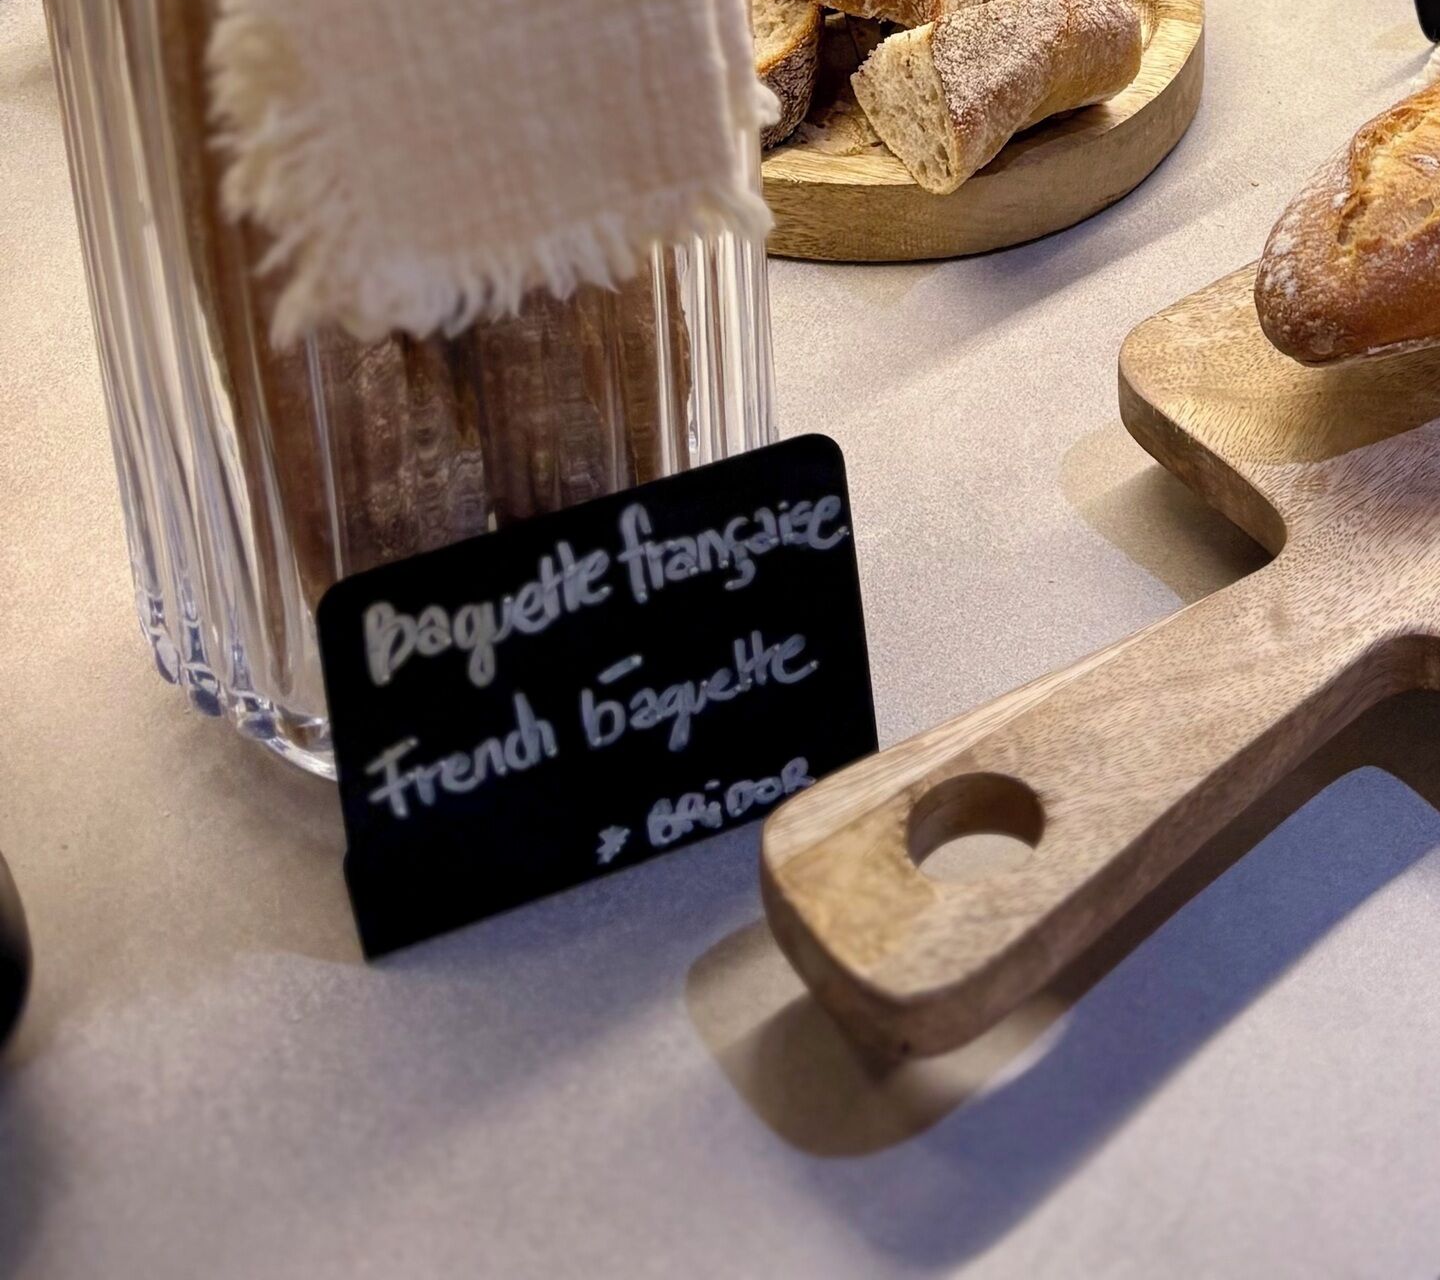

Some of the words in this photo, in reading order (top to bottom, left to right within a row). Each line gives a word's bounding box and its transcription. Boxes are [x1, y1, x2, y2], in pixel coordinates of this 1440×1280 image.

[364, 540, 612, 687] Baguette
[617, 494, 850, 604] française
[366, 690, 559, 819] French
[581, 629, 819, 752] baguette
